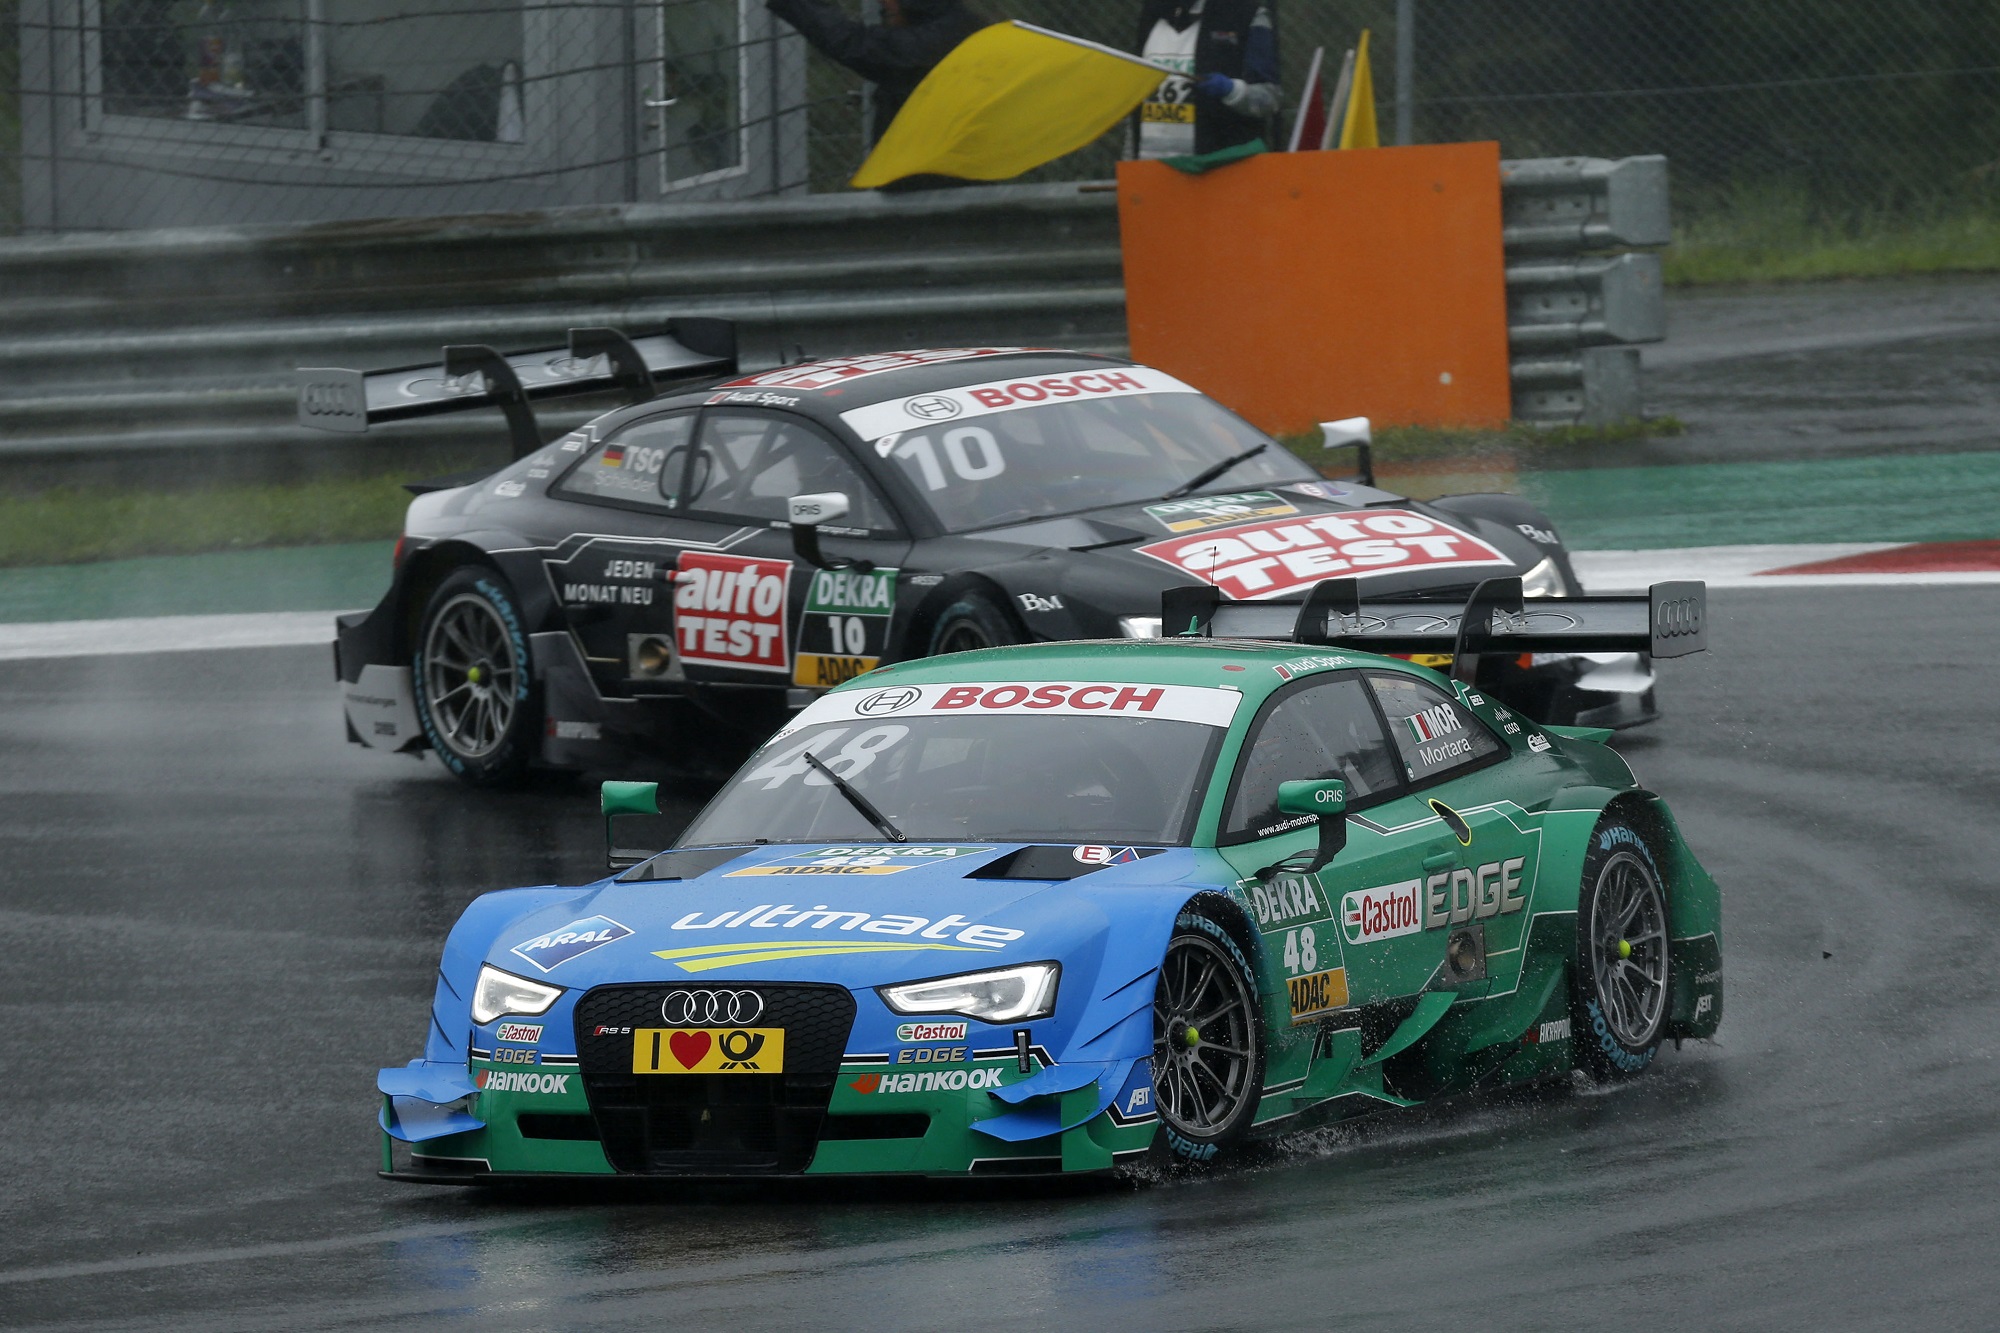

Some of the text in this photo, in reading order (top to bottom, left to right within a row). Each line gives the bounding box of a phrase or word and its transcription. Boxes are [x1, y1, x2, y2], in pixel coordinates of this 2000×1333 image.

[728, 391, 799, 408] Audi Sport
[967, 372, 1147, 408] BOSCH
[625, 446, 664, 474] TSC
[891, 426, 1006, 491] 10
[793, 504, 821, 516] ORIS
[1157, 493, 1270, 513] DEKRA
[1194, 504, 1251, 516] 10
[1200, 509, 1273, 526] ADAC
[1176, 514, 1436, 570] auto
[604, 560, 655, 579] JEDEN
[1208, 535, 1460, 592] TEST
[564, 584, 653, 605] MONAT NEU
[676, 564, 782, 617] auto
[817, 573, 890, 608] DEKRA
[678, 615, 780, 658] TEST
[828, 616, 866, 655] 10
[817, 657, 864, 684] ADAC
[1286, 655, 1352, 673] Audi Sport
[931, 685, 1165, 711] BOSCH
[1422, 703, 1462, 739] MOR
[741, 724, 909, 790] 48
[1419, 738, 1471, 766] Mortara
[1315, 790, 1343, 803] ORIS
[810, 856, 892, 866] 48
[818, 847, 957, 857] DEKRA
[1082, 846, 1103, 861] E
[770, 866, 871, 875] ADAC
[1252, 876, 1320, 925] DEKRA
[1362, 856, 1527, 936] Castrol EDGE
[670, 904, 1025, 948] ultimate
[525, 929, 614, 952] ARAL
[1284, 926, 1318, 975] 48
[1290, 973, 1331, 1014] ADAC
[506, 1025, 541, 1042] Castrol
[600, 1027, 631, 1035] RS 5
[914, 1024, 965, 1041] Castrol
[494, 1048, 539, 1065] EDGE
[651, 1032, 661, 1070] I
[897, 1047, 969, 1064] EDGE
[1126, 1087, 1150, 1113] ABT
